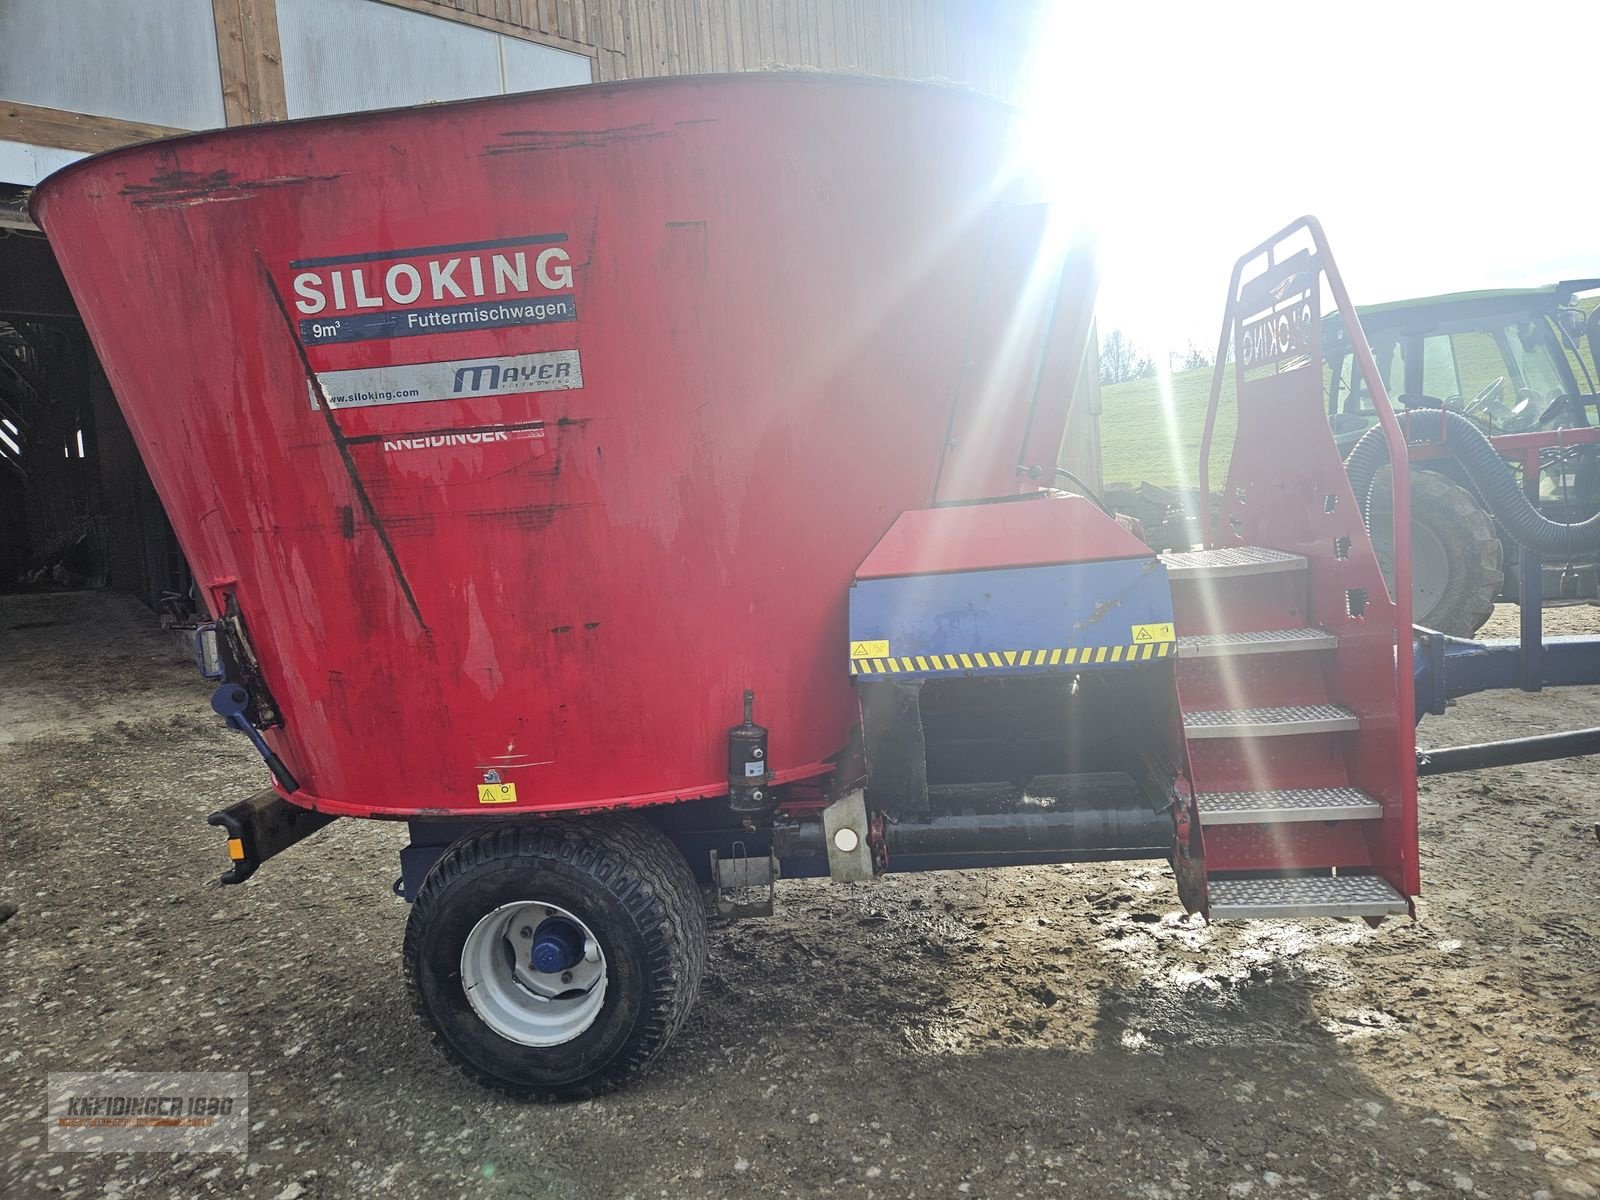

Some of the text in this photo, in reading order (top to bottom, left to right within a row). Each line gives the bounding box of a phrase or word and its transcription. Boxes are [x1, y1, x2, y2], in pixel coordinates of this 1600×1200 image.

[293, 247, 574, 315] SILOKING
[407, 301, 567, 329] Futtermischwagen
[453, 362, 571, 393] MAYER
